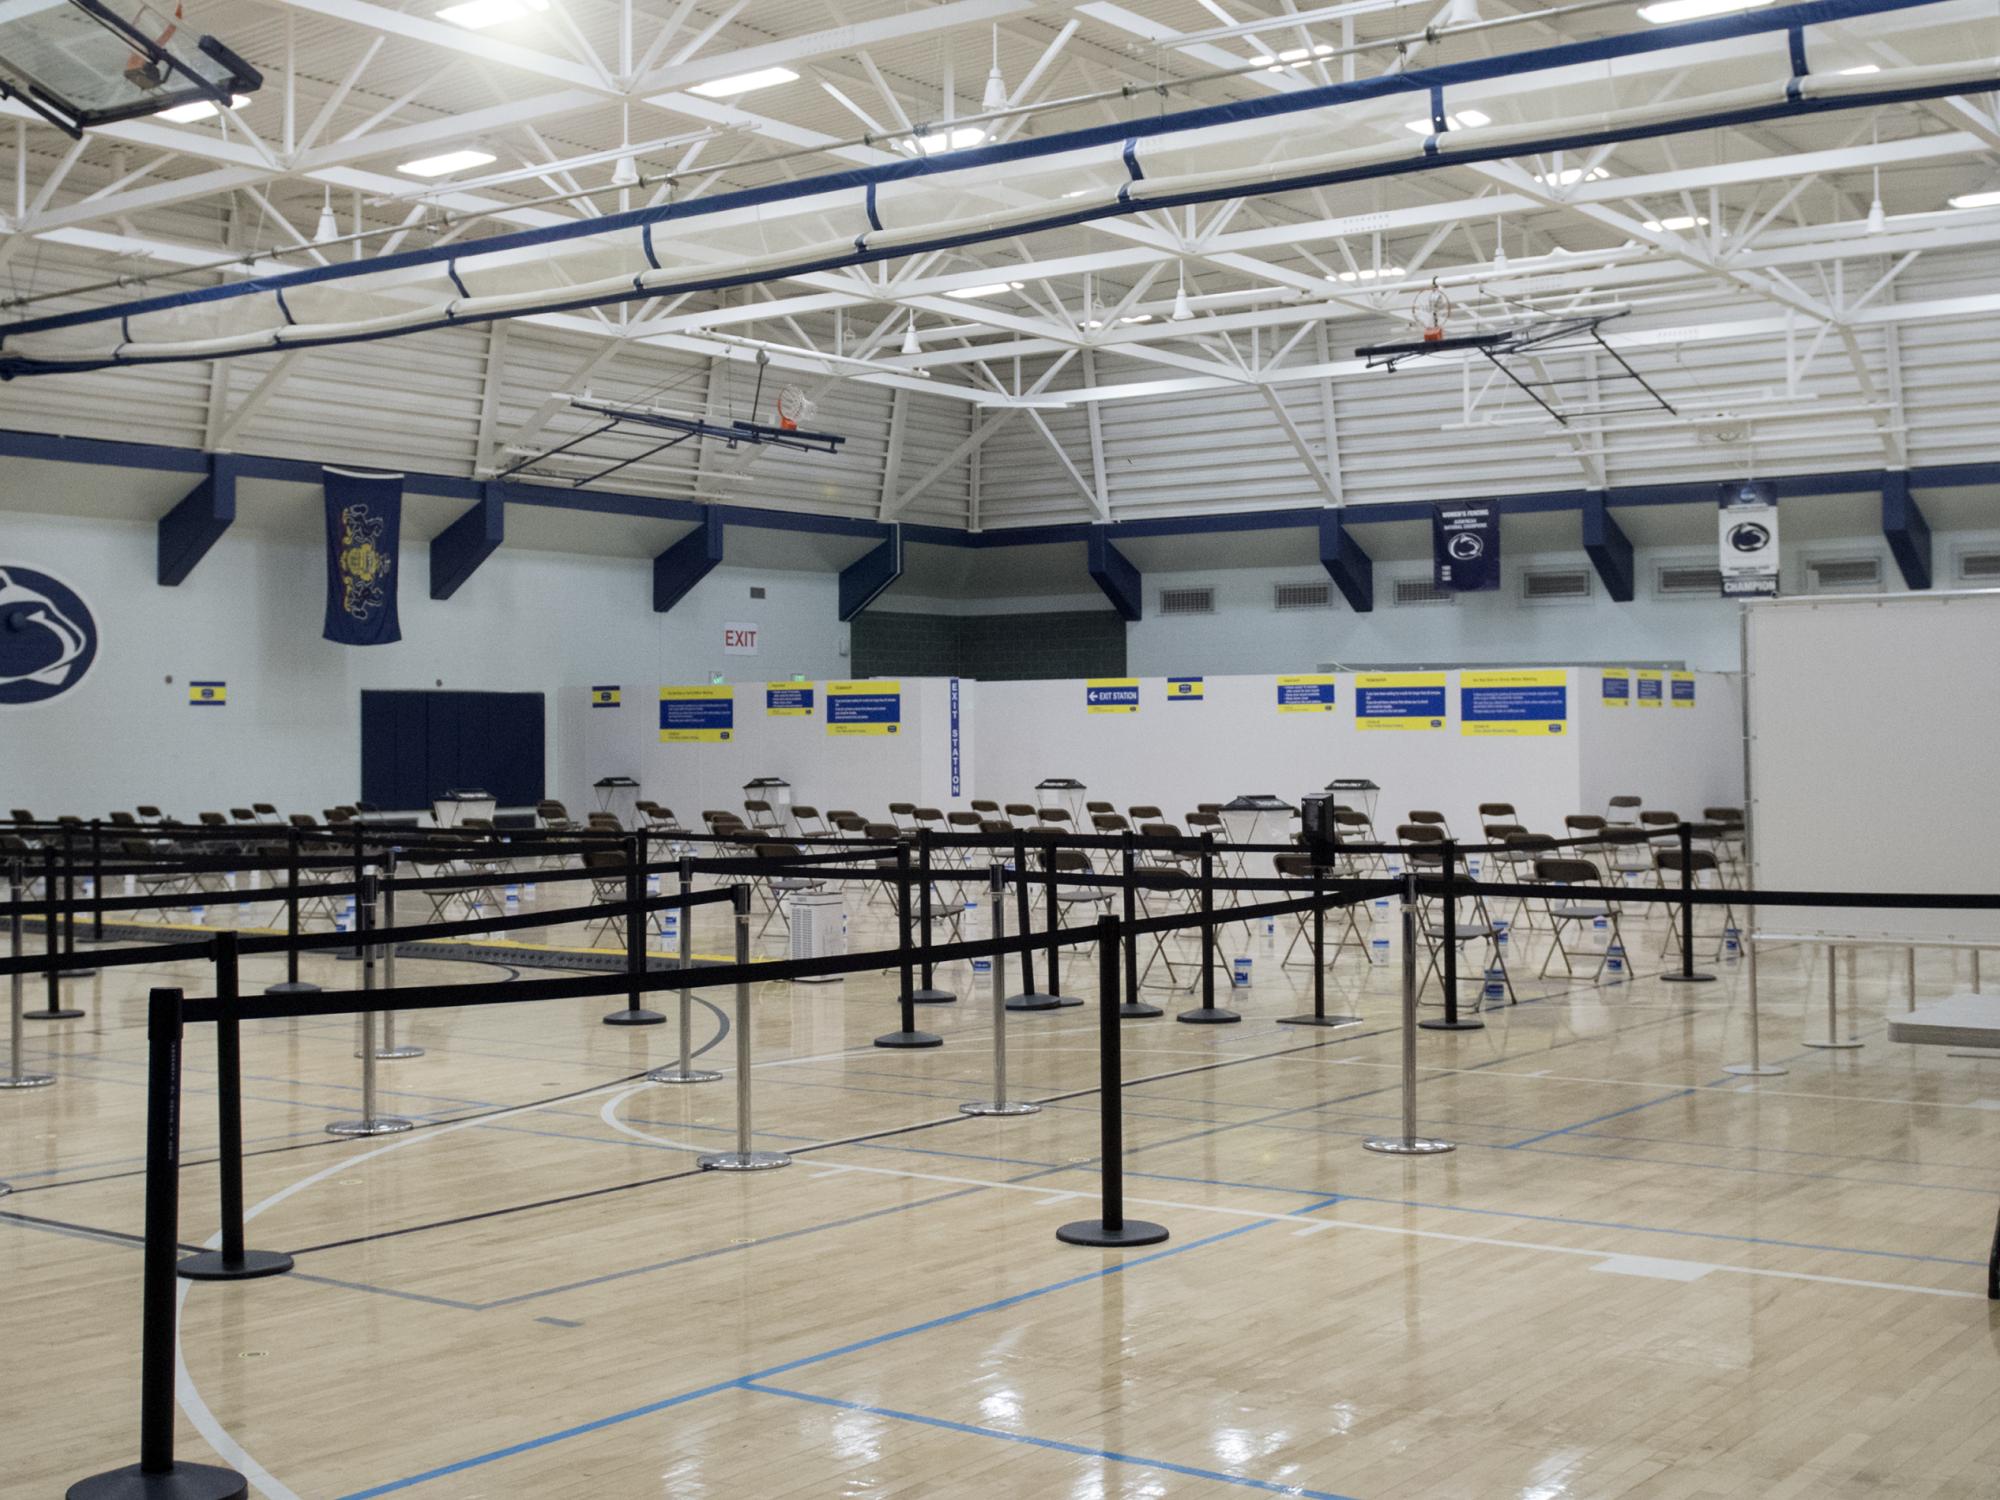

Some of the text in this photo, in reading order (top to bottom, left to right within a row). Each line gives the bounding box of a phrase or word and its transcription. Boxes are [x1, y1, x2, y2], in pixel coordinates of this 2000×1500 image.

[1724, 581, 1776, 592] CHAMPION
[725, 630, 757, 648] EXIT
[1099, 691, 1136, 700] EXIT STATION
[951, 682, 960, 794] EXIT STATION
